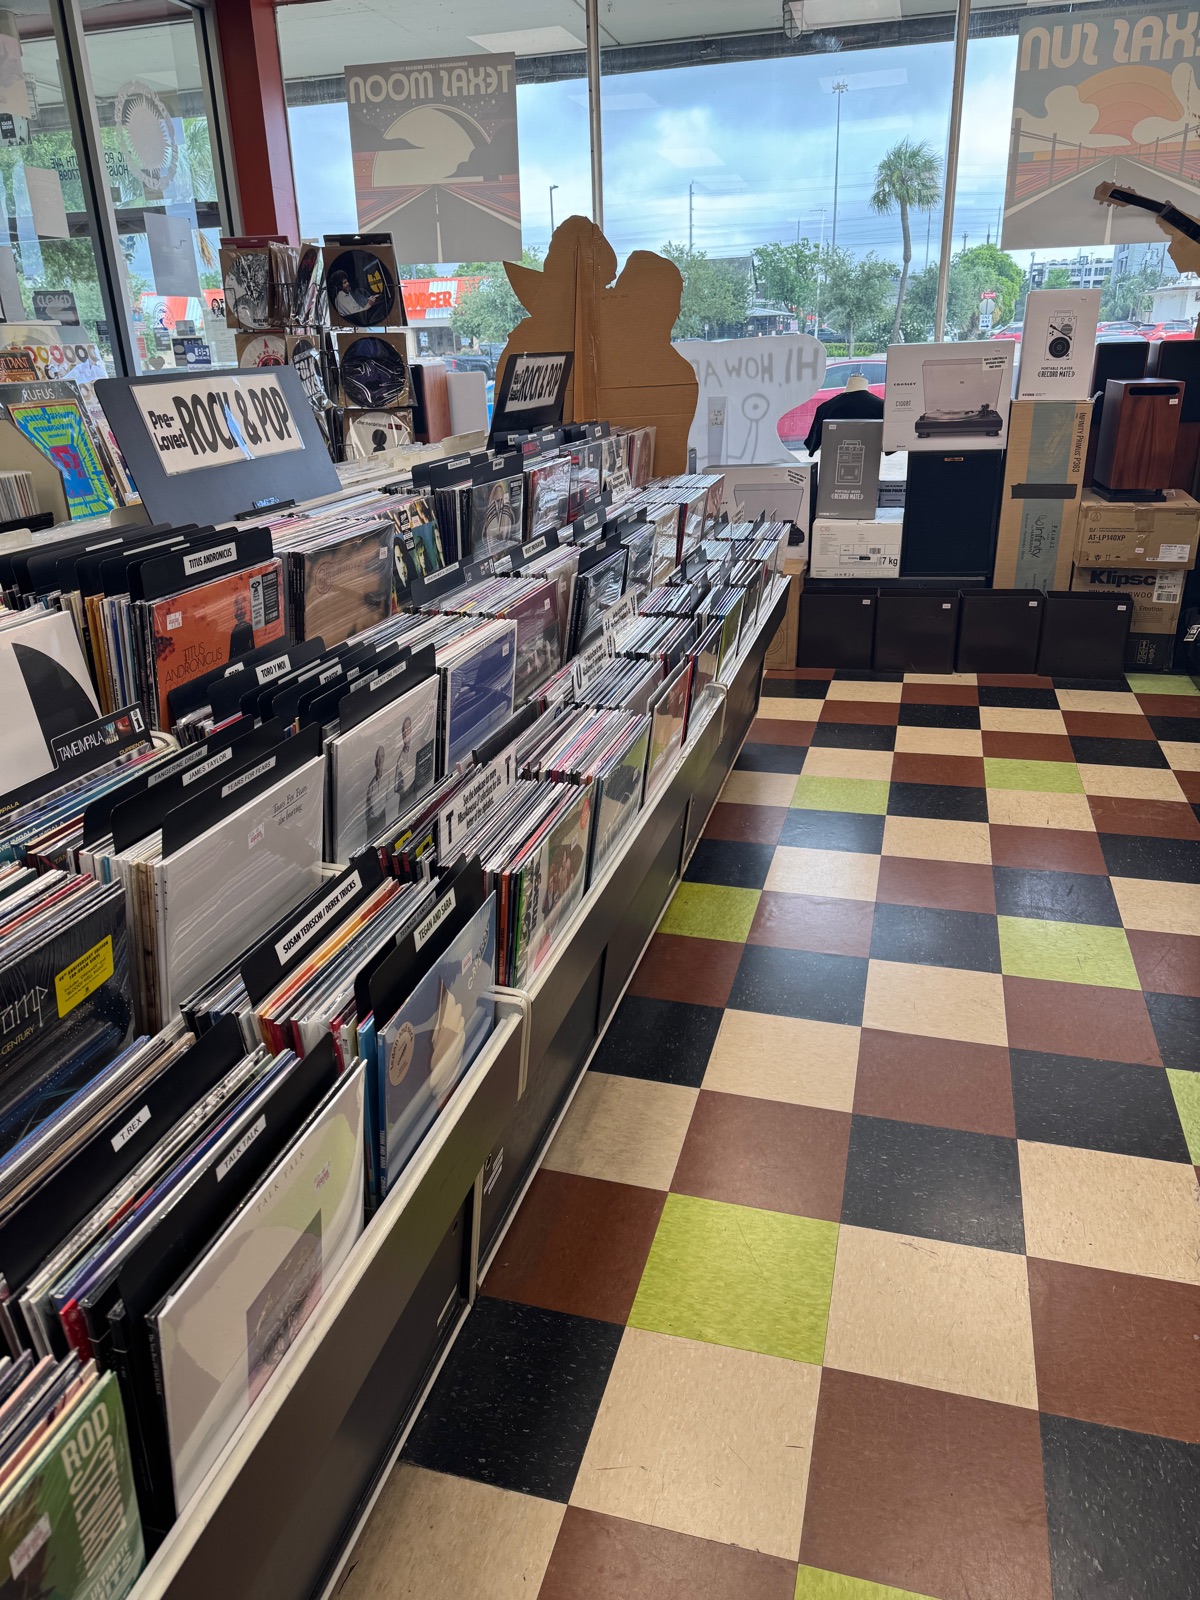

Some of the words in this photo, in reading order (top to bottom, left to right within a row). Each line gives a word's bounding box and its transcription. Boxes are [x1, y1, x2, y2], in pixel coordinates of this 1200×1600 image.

[22, 388, 55, 403] RUFUS
[543, 363, 562, 398] POP
[148, 410, 175, 430] Pre-
[172, 391, 241, 456] ROCK
[236, 390, 263, 446] &
[248, 386, 293, 443] POP
[1077, 412, 1087, 435] INFINITY
[154, 428, 189, 452] Loved
[1074, 435, 1085, 458] PRIMUS
[1072, 458, 1081, 473] P363
[1030, 527, 1046, 559] Infinity
[188, 556, 203, 570] TITUS
[202, 548, 233, 566] ANDRONICUS
[882, 557, 887, 565] 7
[889, 557, 898, 567] kg
[1090, 570, 1157, 588] Klipsc
[165, 647, 223, 682] ANDRONICUS
[182, 642, 206, 663] TITUS
[261, 667, 274, 679] TORO
[277, 661, 287, 671] MOI
[373, 677, 386, 687] TWENTY
[393, 665, 404, 675] PILOTS
[154, 762, 185, 782] TANGERINE
[185, 750, 203, 765] DREAM
[188, 766, 207, 781] JAMES
[207, 752, 228, 769] TAYLOR
[228, 779, 245, 793] TEARS
[244, 772, 256, 782] FOR
[255, 762, 271, 776] FEARS
[505, 754, 512, 786] T
[273, 801, 286, 814] Tears
[286, 794, 295, 804] For
[446, 810, 454, 845] T
[283, 932, 302, 954] SUSAN
[300, 911, 324, 937] TEDESCHI
[325, 895, 341, 914] DEREK
[339, 880, 357, 900] TRUCKS
[418, 918, 433, 942] TEGAN
[433, 910, 442, 926] AND
[441, 897, 452, 916] SARA
[1, 1025, 35, 1055] CENTURY
[120, 1116, 143, 1142] T.REX
[223, 1148, 242, 1170] TALK
[242, 1126, 260, 1150] TALK
[256, 1184, 280, 1213] TALK
[283, 1150, 306, 1178] TALK
[60, 1402, 109, 1480] ROD
[69, 1434, 127, 1578] STEWART
[90, 1538, 131, 1600] ULTIMATE
[98, 1551, 133, 1600] ITS
